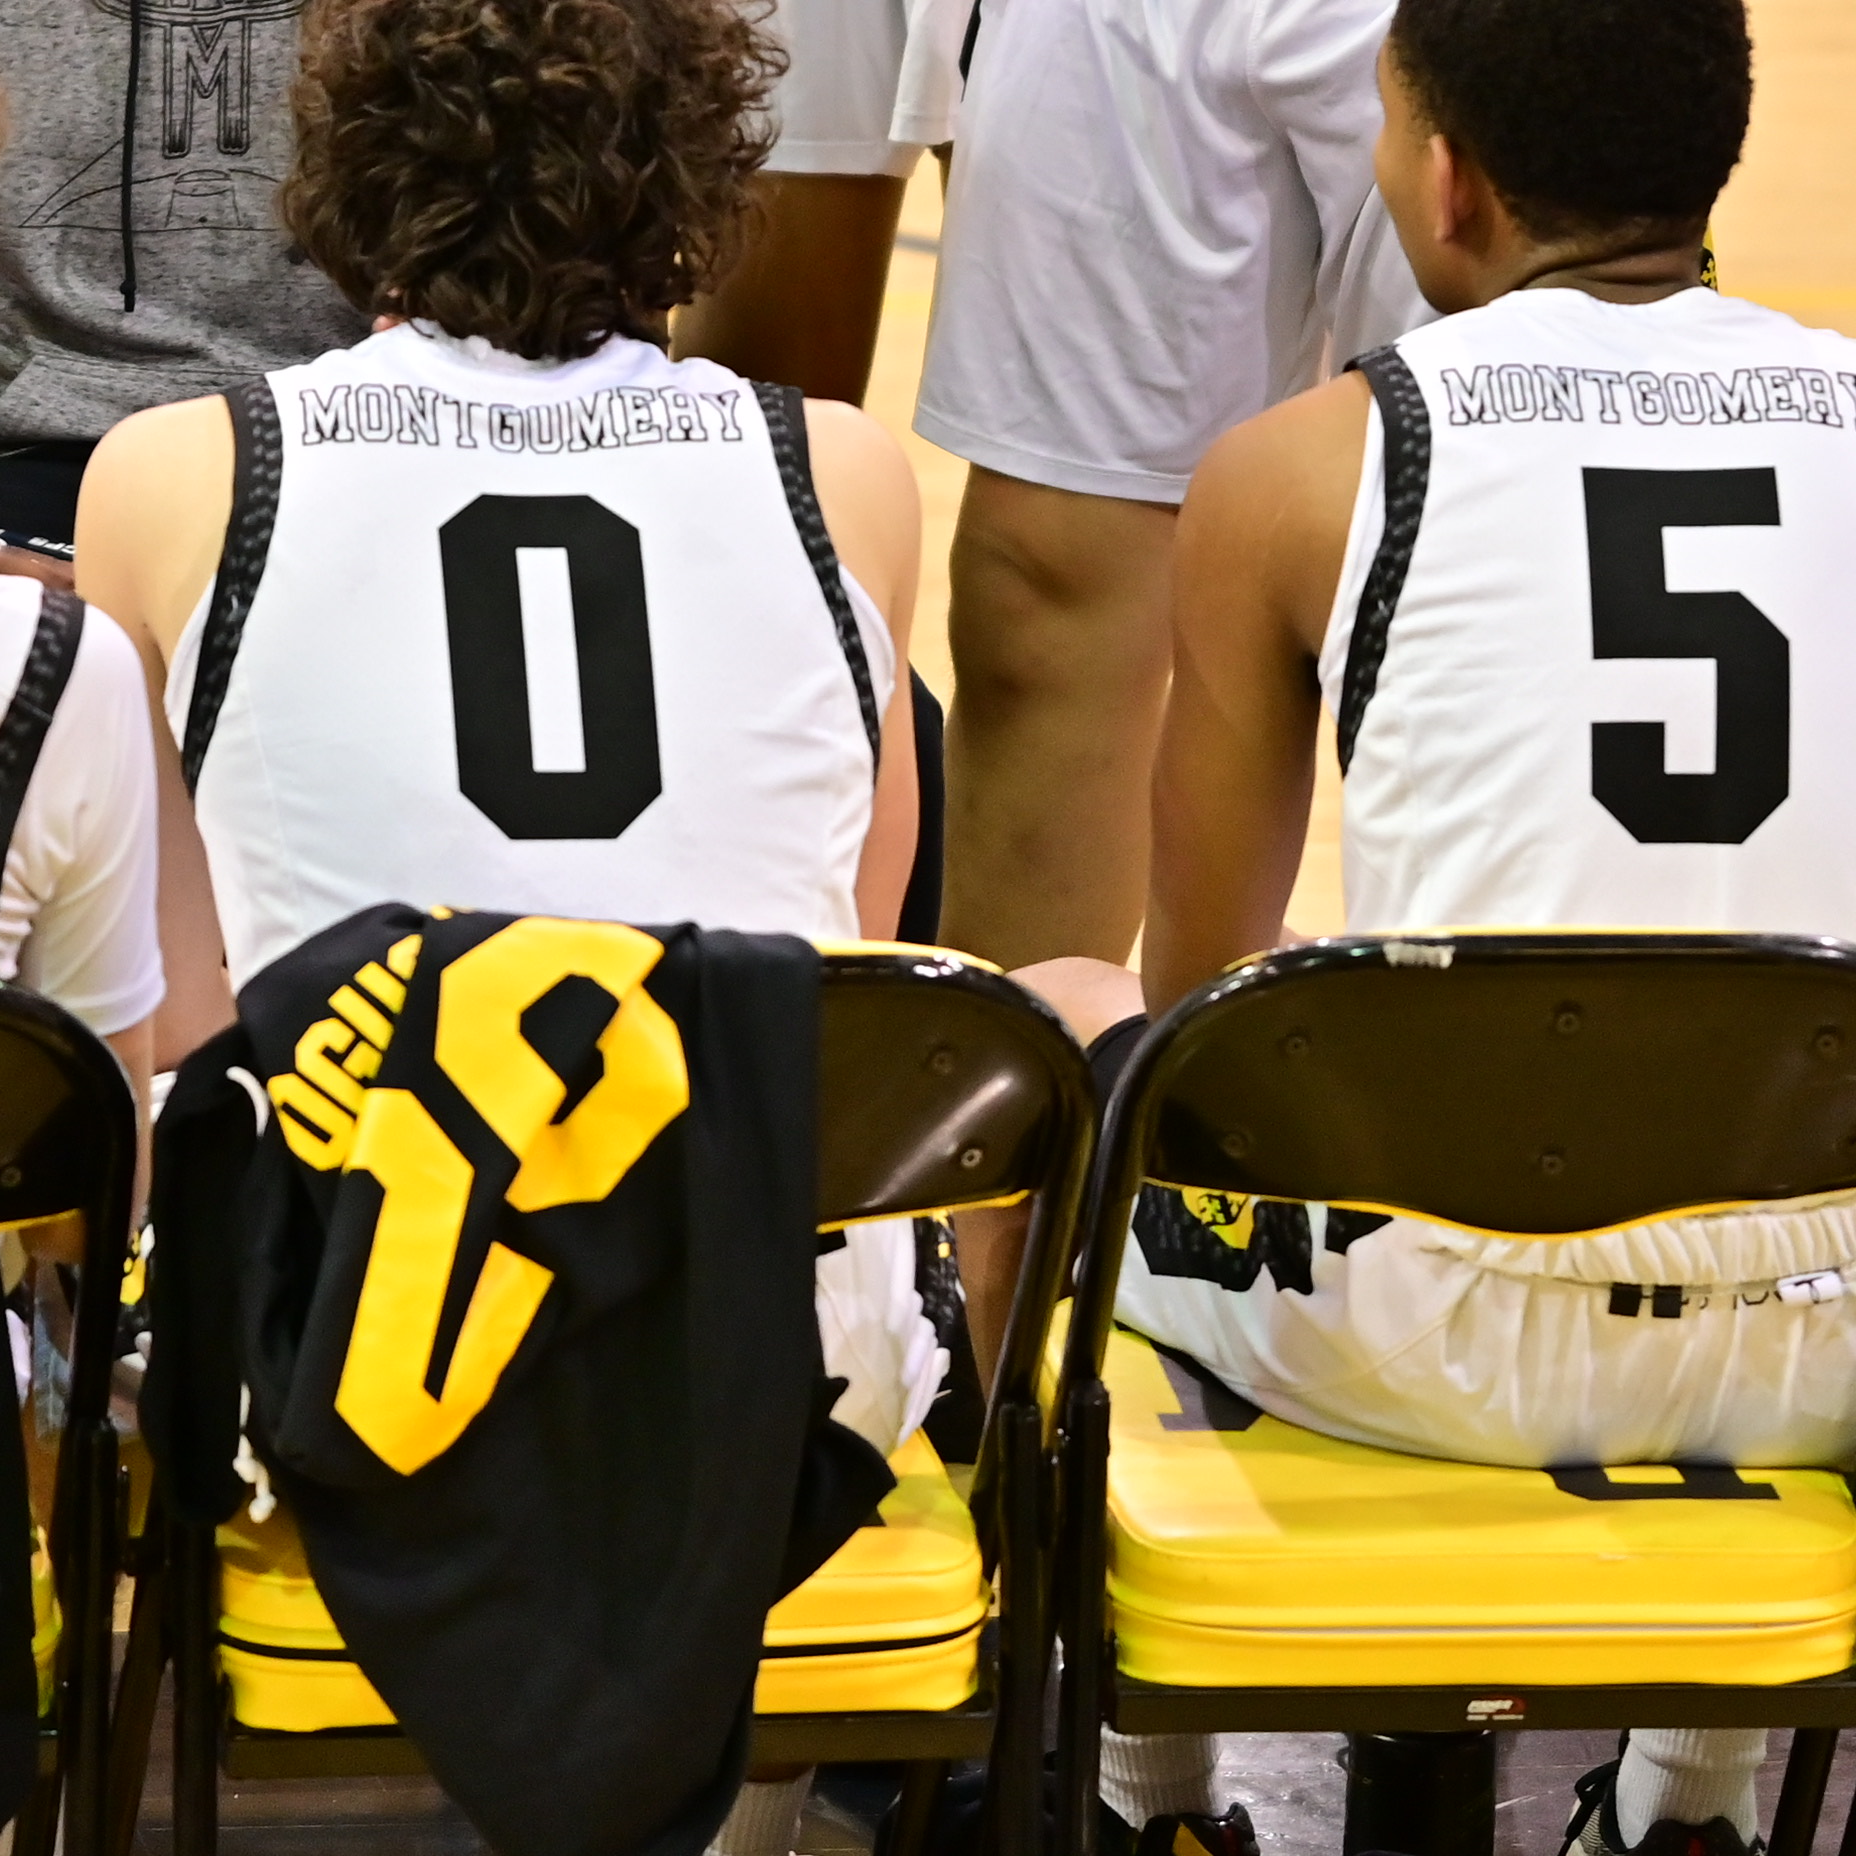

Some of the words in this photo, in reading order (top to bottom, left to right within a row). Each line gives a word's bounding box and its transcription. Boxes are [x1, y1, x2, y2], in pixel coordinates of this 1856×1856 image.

[299, 384, 743, 454] MONTGOMERY
[438, 493, 662, 840] 0
[1581, 466, 1790, 844] 5
